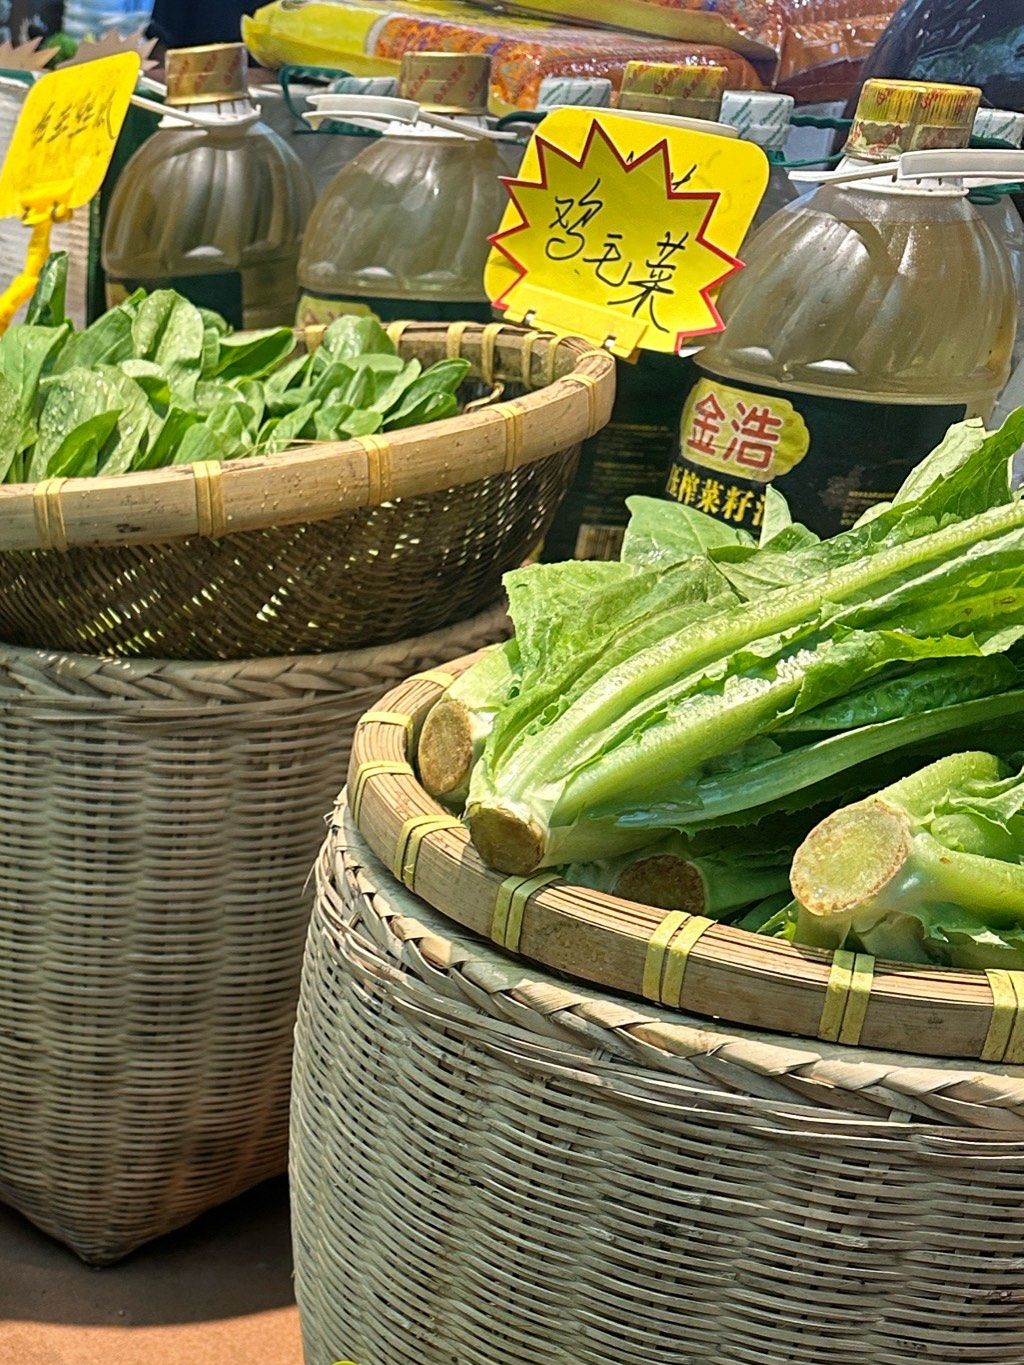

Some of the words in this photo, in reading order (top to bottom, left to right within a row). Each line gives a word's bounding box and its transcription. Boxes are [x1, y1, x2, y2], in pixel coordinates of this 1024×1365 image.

[545, 177, 687, 332] 鸡毛菜
[685, 392, 783, 471] 金浩
